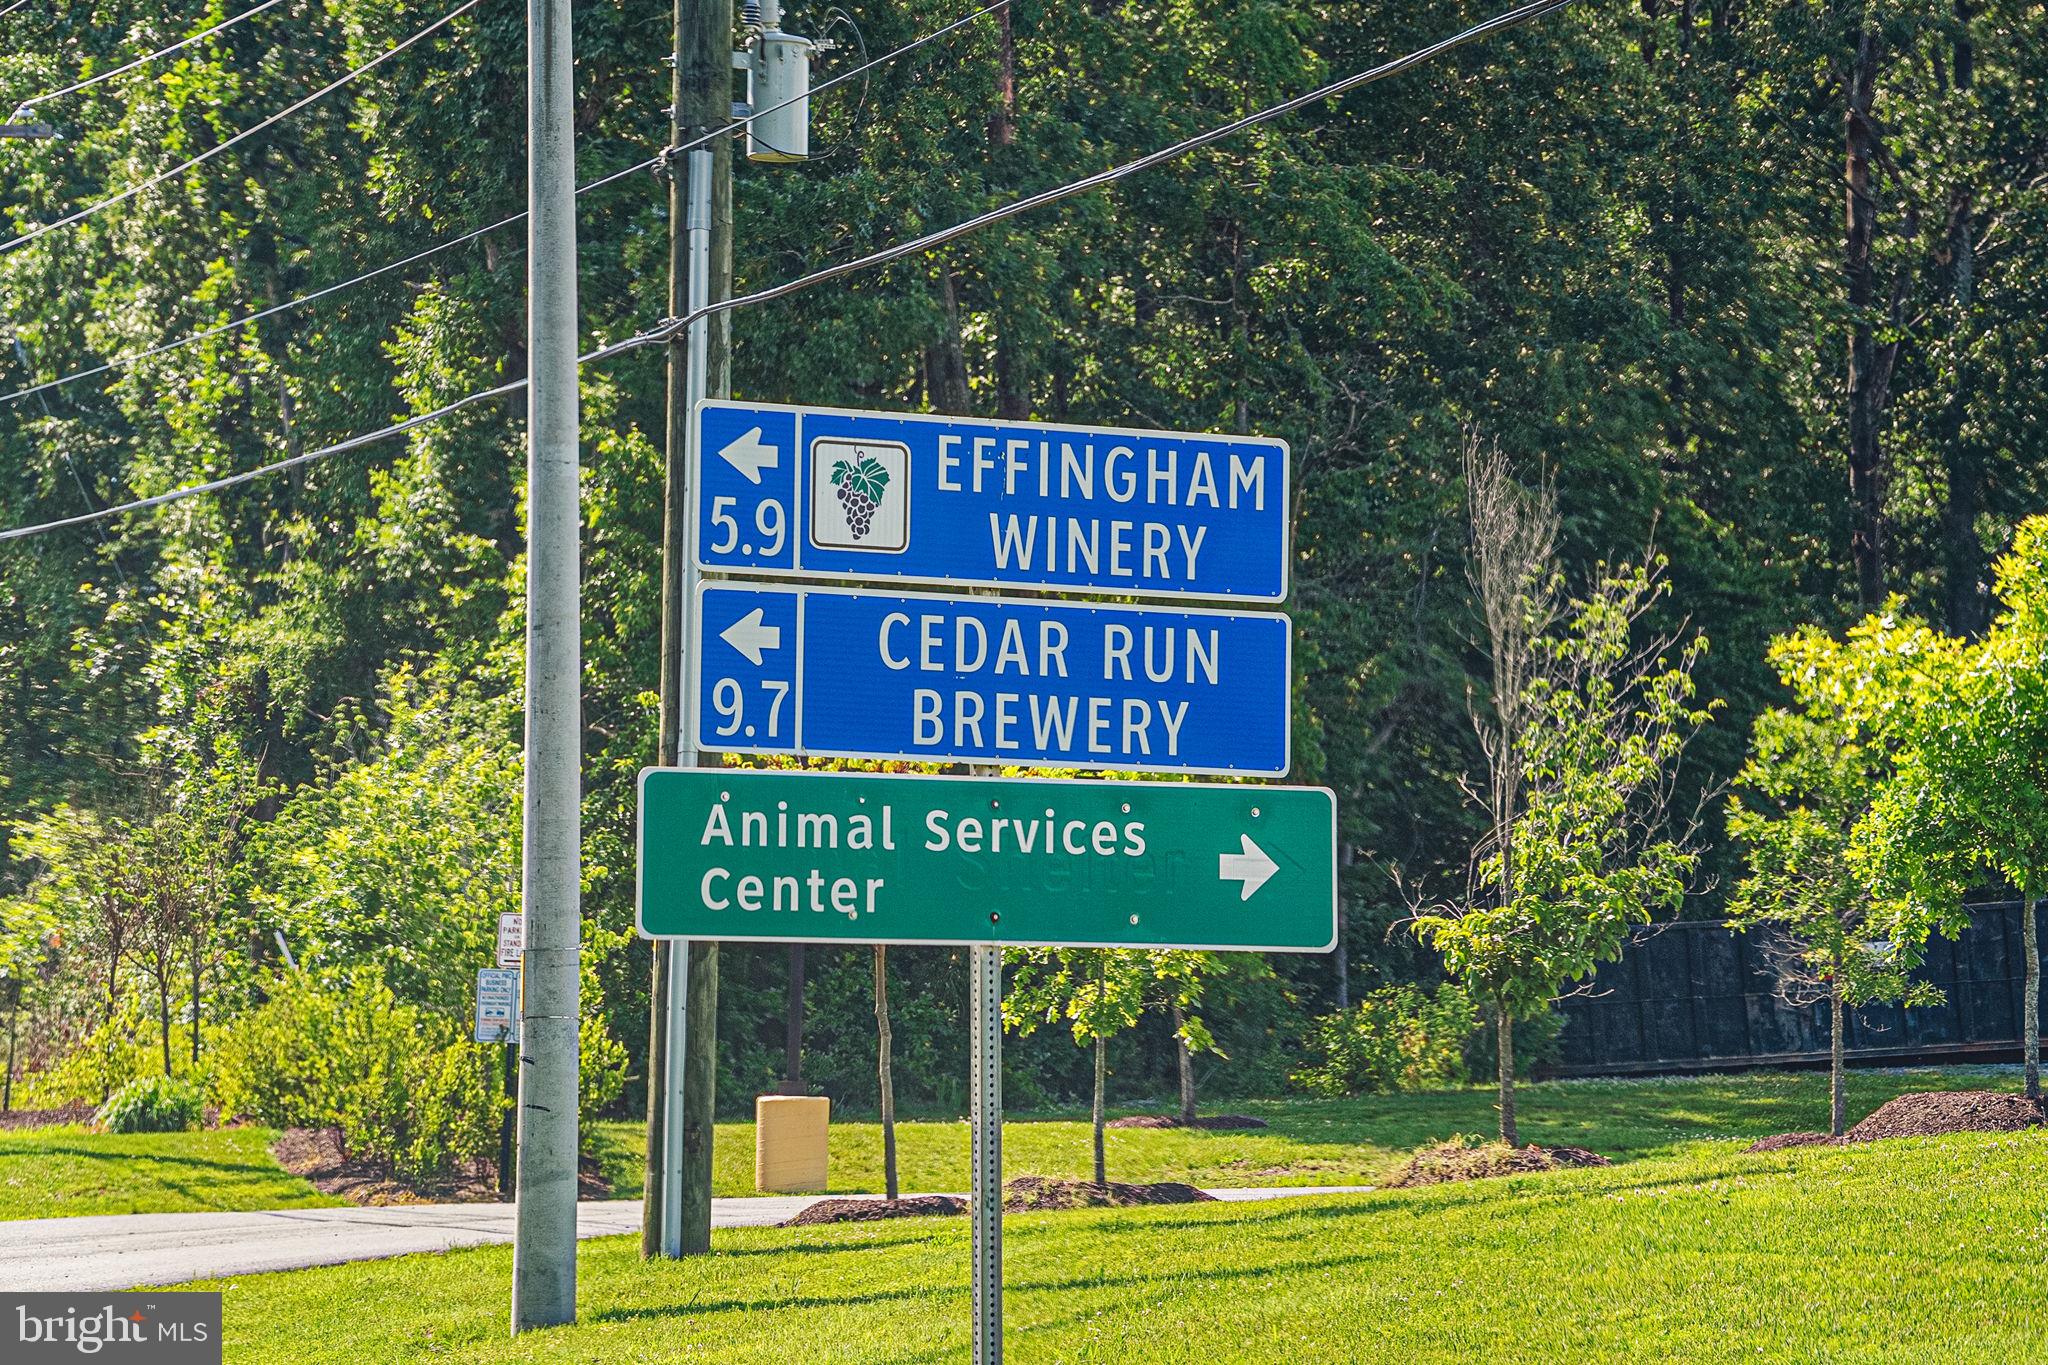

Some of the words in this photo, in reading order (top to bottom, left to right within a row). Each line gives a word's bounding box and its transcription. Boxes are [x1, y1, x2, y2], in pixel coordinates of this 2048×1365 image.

[937, 434, 1265, 511] EFFINGHAM
[710, 496, 786, 557] 5.9
[989, 512, 1207, 581] WINERY
[879, 612, 1069, 679] CEDAR
[1103, 624, 1220, 686] RUN
[712, 677, 789, 738] 9.7
[913, 688, 1190, 757] BREWERY
[700, 801, 896, 851] Animal
[923, 808, 1148, 857] Services
[700, 867, 885, 914] Center
